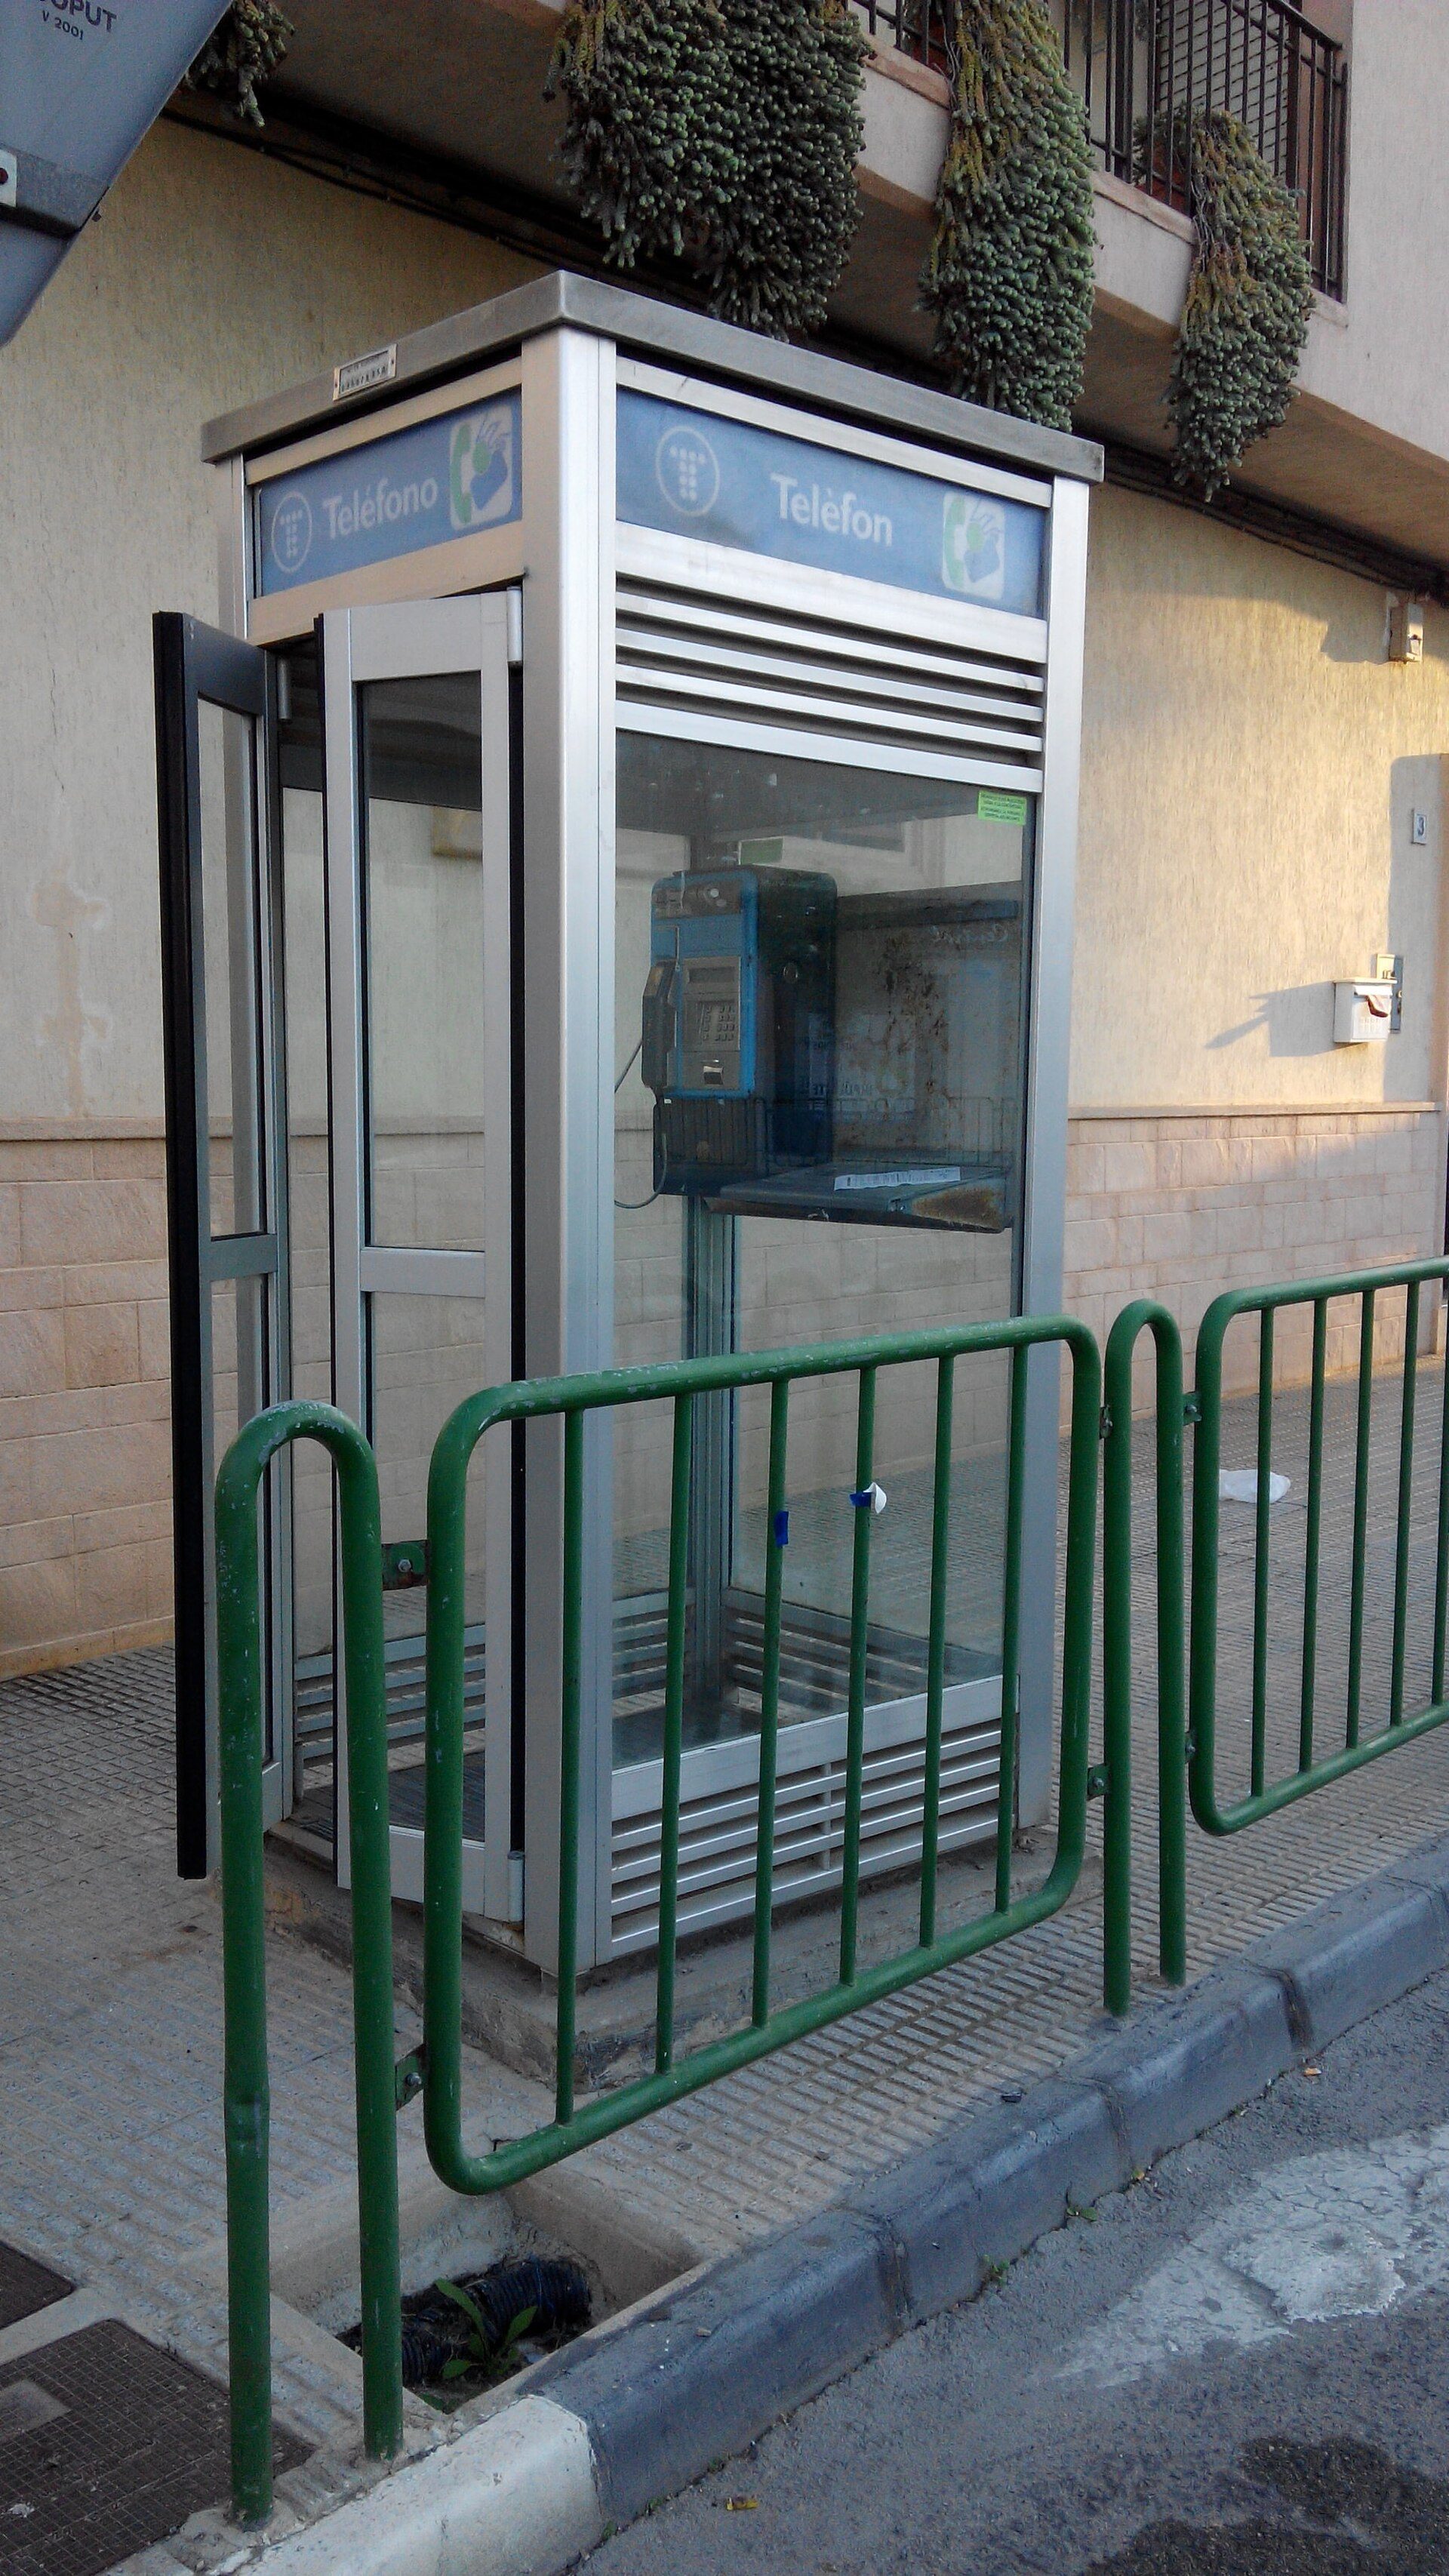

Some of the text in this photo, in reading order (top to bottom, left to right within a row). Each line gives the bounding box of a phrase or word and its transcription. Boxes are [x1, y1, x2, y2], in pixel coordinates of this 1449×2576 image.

[54, 17, 84, 41] 2001
[323, 478, 438, 539] Teléfono
[771, 473, 892, 547] Telèfon
